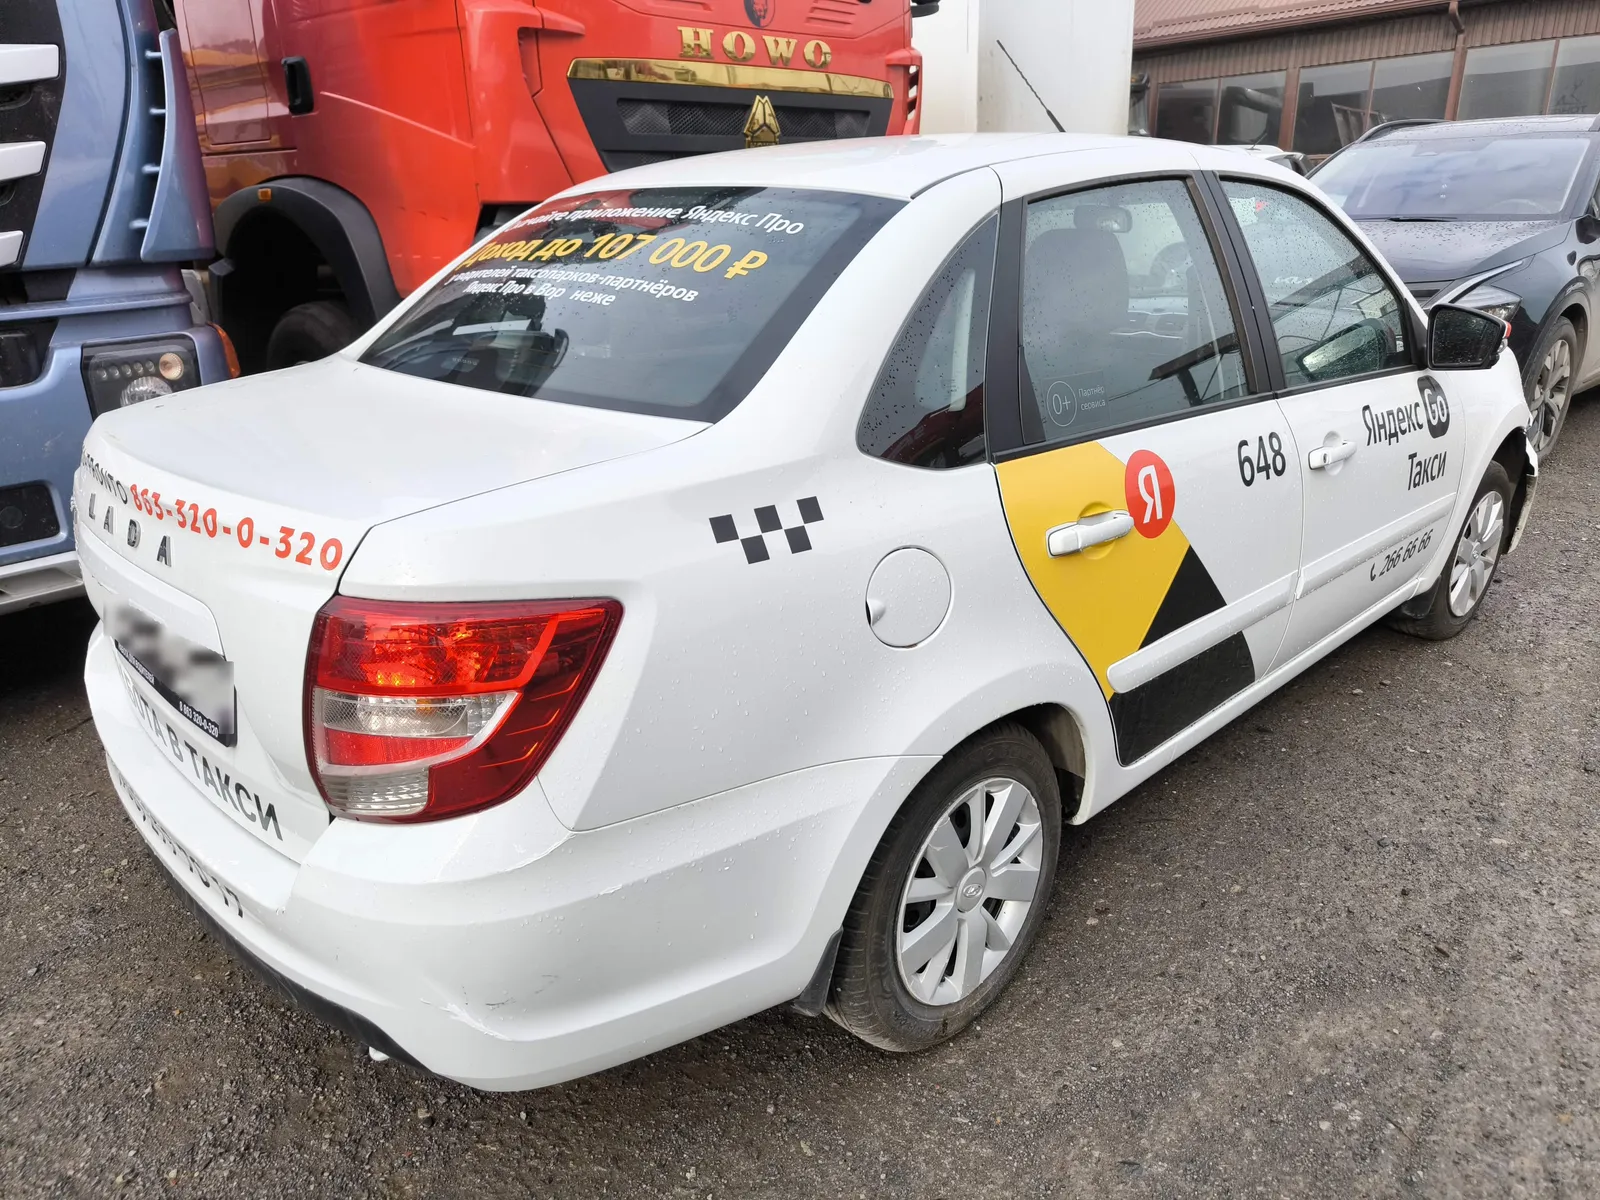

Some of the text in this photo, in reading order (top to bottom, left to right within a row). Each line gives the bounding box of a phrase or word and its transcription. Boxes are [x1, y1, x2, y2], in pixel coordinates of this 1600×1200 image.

[677, 26, 832, 69] HOWO
[564, 205, 683, 222] приложение
[681, 205, 758, 226] Яндекс
[755, 212, 804, 234] Про
[455, 239, 543, 271] Доход
[528, 238, 583, 262] до
[583, 232, 657, 262] 107
[648, 237, 732, 273] 000
[498, 280, 526, 296] Про
[523, 285, 536, 296] в
[511, 267, 699, 302] таксопарков-партнёров
[1077, 385, 1105, 398] Партнёр
[1080, 399, 1106, 412] сервиса
[1362, 388, 1448, 447] Яндекс Go
[1237, 431, 1287, 487] 648
[1407, 450, 1448, 491] Такси
[1137, 464, 1163, 525] Я
[87, 492, 173, 568] LADA
[129, 483, 343, 571] 863-320-0-320
[1379, 528, 1434, 577] 266 66 66
[193, 712, 219, 738] 320-0-320
[184, 739, 284, 842] ТАКСИ
